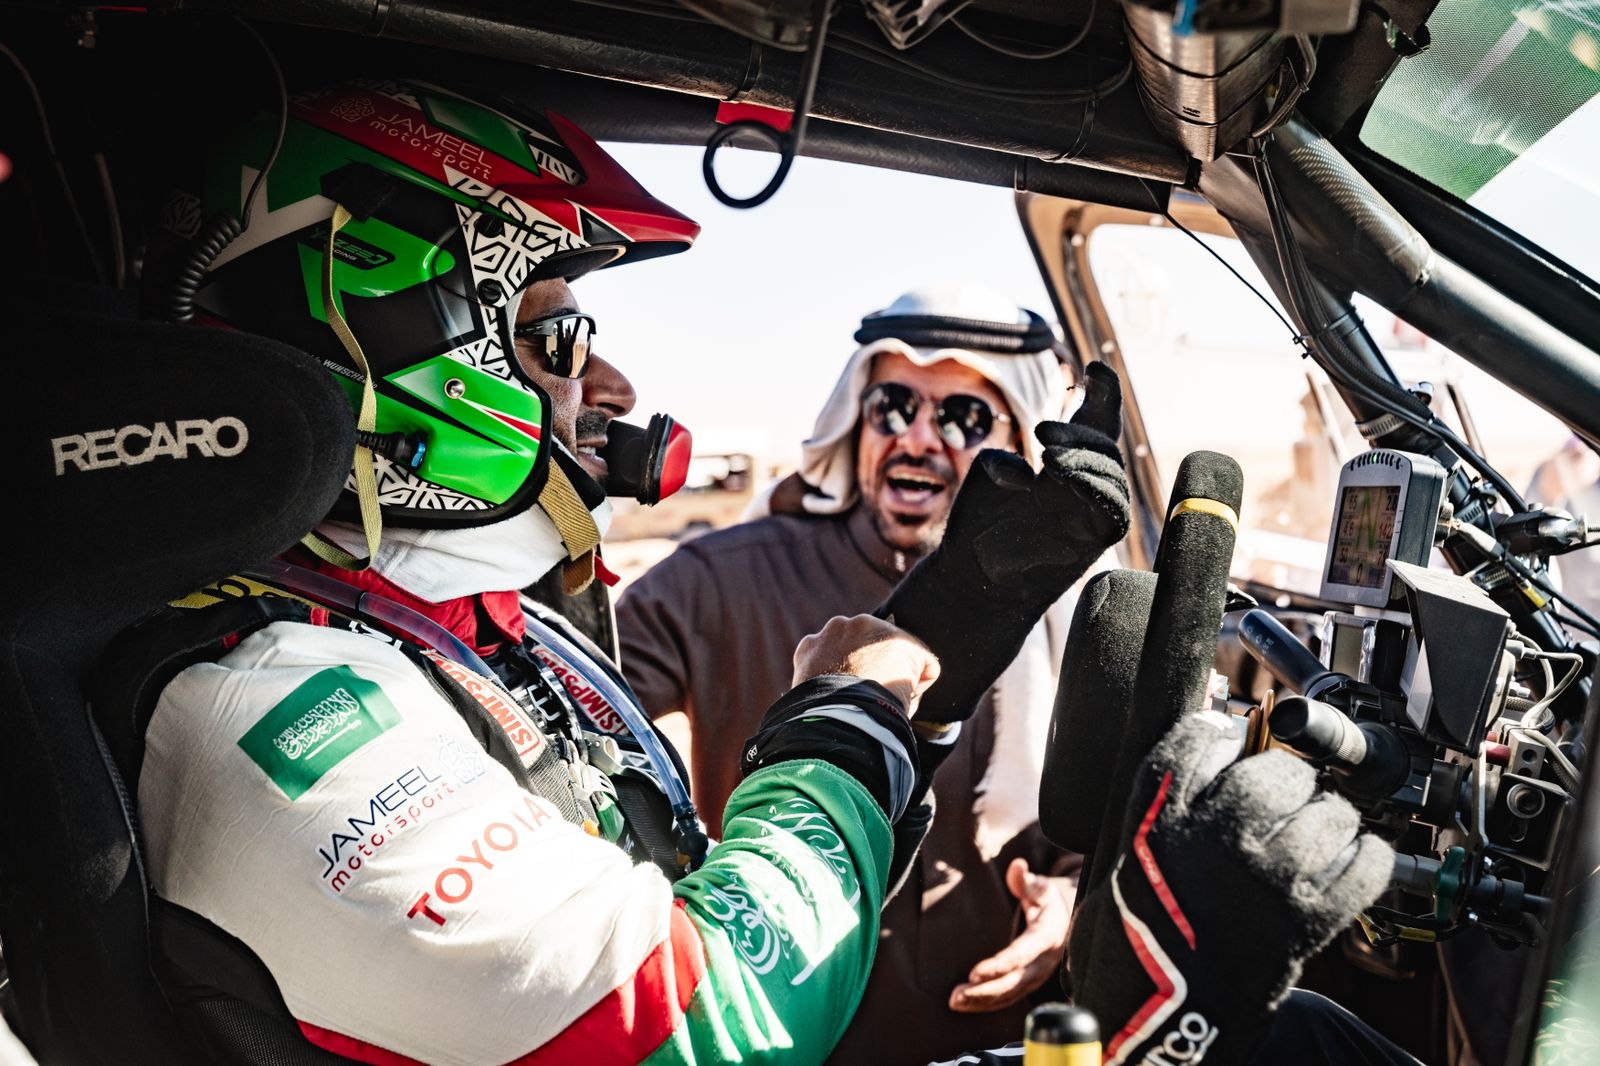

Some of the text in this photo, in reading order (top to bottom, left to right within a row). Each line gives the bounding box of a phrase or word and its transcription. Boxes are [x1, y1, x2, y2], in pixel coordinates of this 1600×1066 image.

[378, 113, 493, 170] JAMEEL
[51, 416, 249, 476] RECARO
[318, 766, 442, 878] JAMEEL
